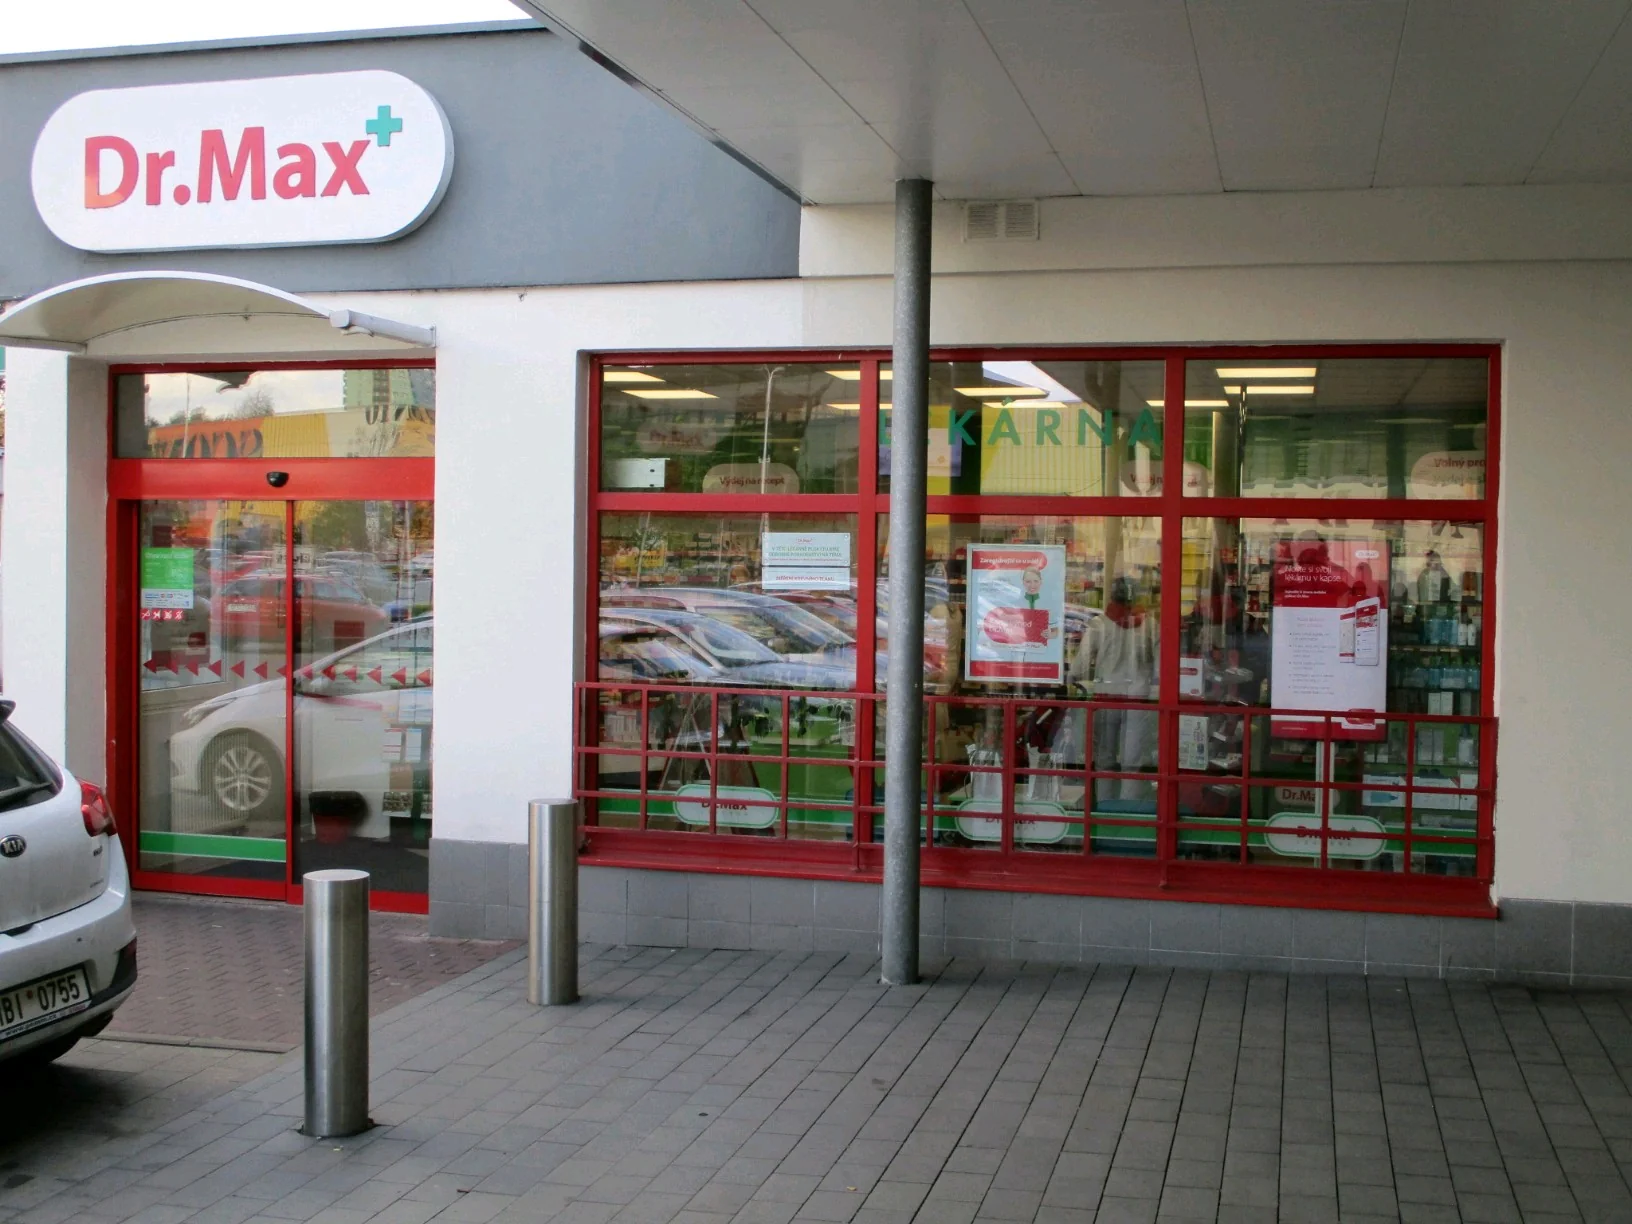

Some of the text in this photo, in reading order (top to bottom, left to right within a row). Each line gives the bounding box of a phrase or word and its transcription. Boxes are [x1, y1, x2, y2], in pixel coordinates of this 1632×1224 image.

[84, 126, 371, 209] Dr.Max
[879, 396, 1163, 446] LKÁRNA
[720, 475, 744, 488] Výdej
[757, 477, 785, 487] rcept
[1282, 788, 1316, 802] Dr.Ma
[3, 838, 24, 854] KIA
[0, 992, 23, 1027] BI
[37, 974, 80, 1011] 0755
